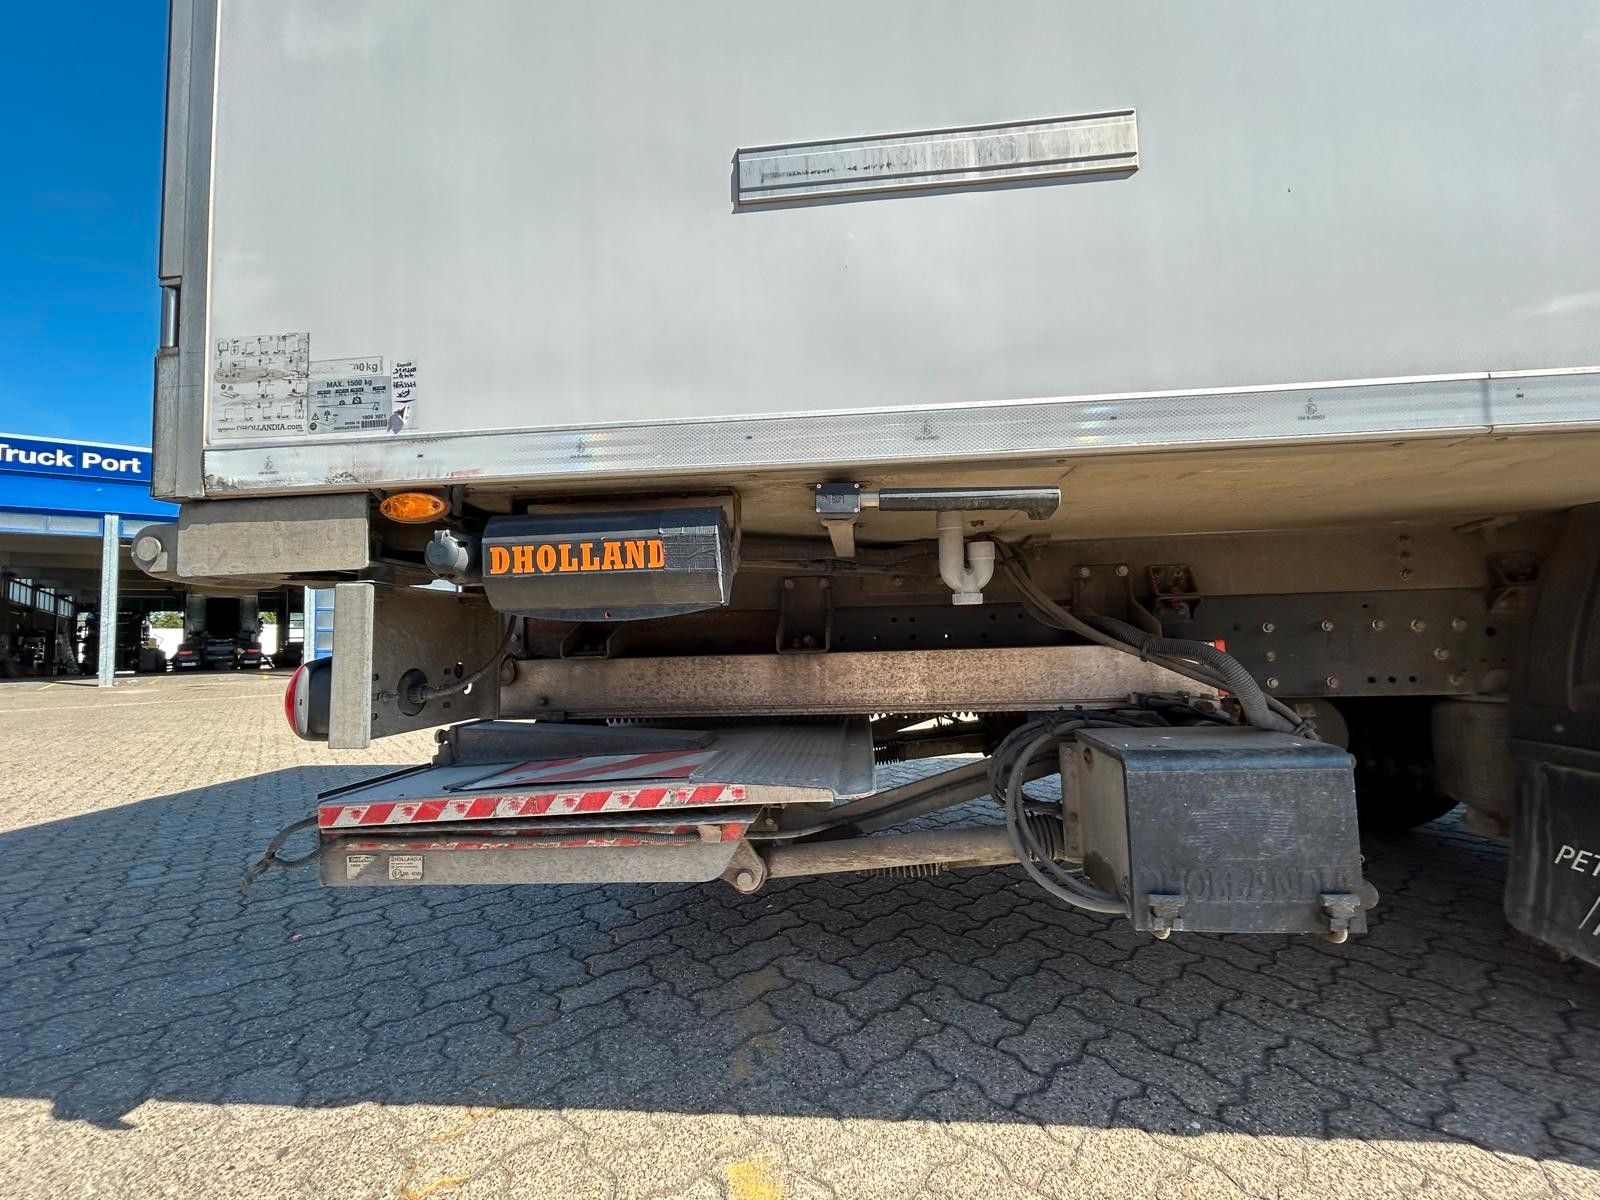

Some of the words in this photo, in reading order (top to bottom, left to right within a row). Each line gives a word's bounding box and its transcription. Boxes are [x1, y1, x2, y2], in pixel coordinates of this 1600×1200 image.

[347, 379, 362, 387] 1500
[0, 443, 74, 467] Truck
[82, 452, 141, 473] Port
[489, 538, 665, 575] DHOLLAND
